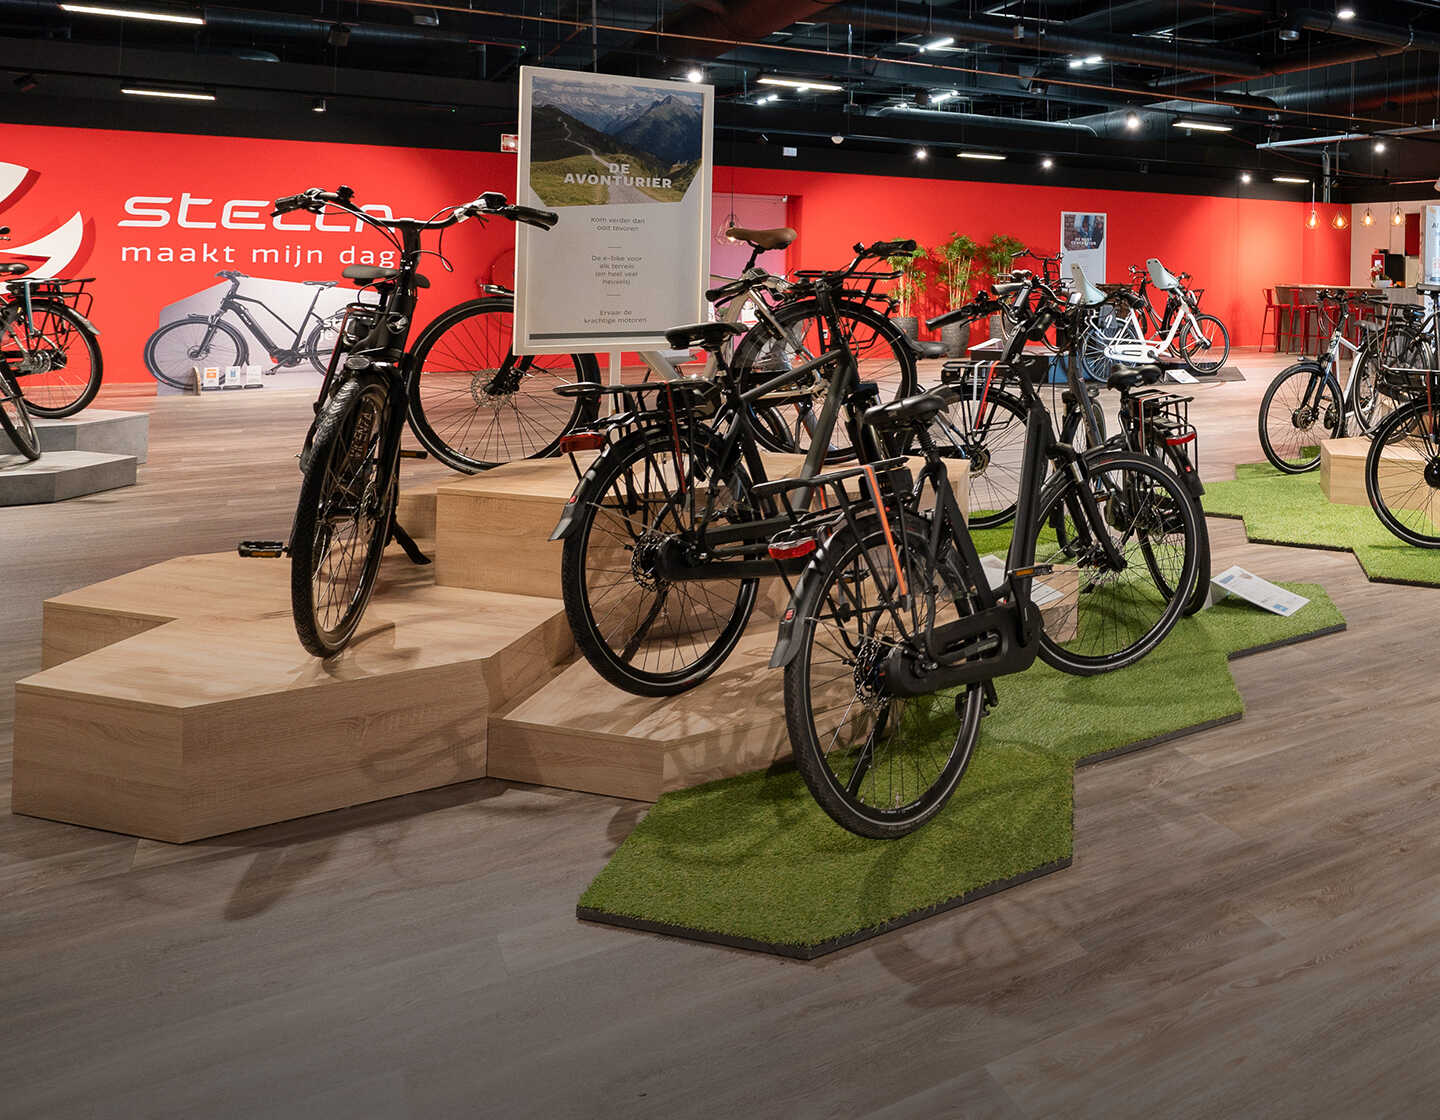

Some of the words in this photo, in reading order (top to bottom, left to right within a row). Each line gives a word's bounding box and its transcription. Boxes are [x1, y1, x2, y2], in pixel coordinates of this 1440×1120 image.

[609, 163, 630, 174] DE
[564, 173, 672, 188] AVONTURIER
[121, 243, 236, 263] maakt
[252, 245, 323, 268] mijn
[339, 246, 396, 268] dag
